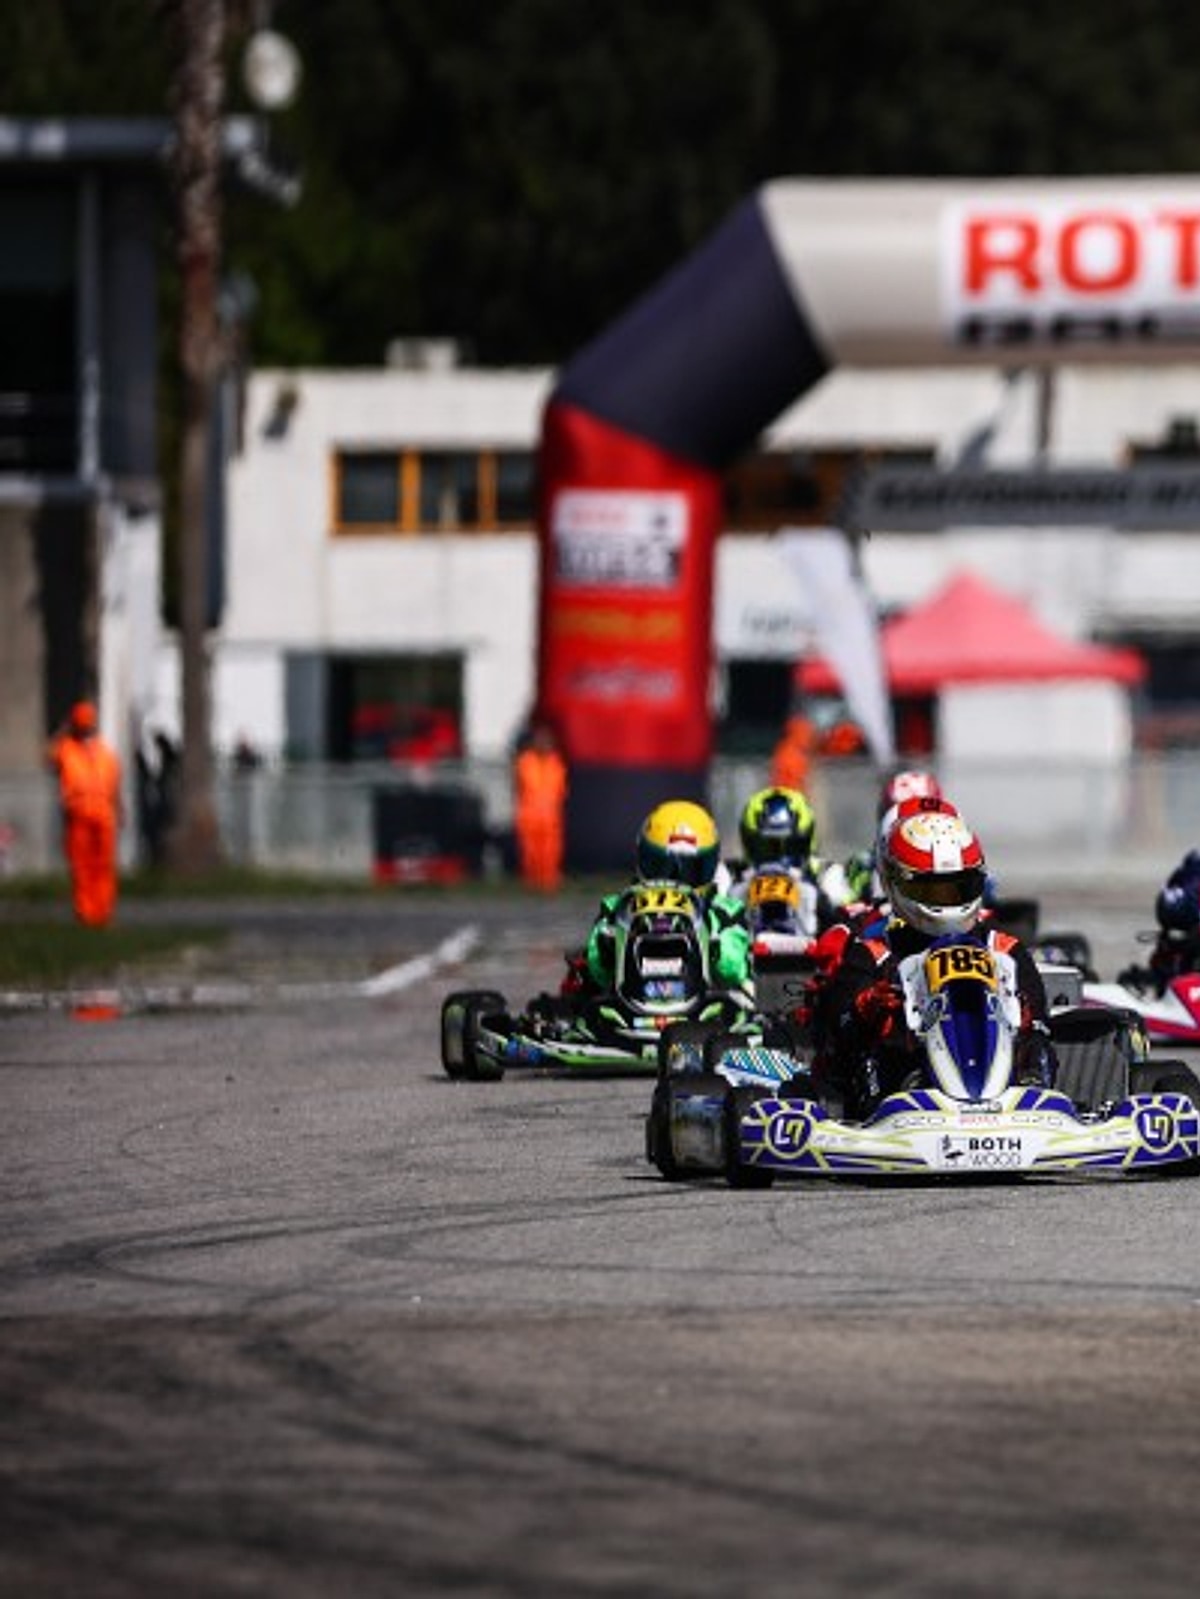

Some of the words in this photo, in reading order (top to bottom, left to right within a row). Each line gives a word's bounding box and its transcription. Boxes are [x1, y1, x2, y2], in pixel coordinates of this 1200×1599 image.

[930, 947, 995, 978] 785
[968, 1137, 1022, 1151] BOTH
[969, 1153, 1021, 1167] WOOD
